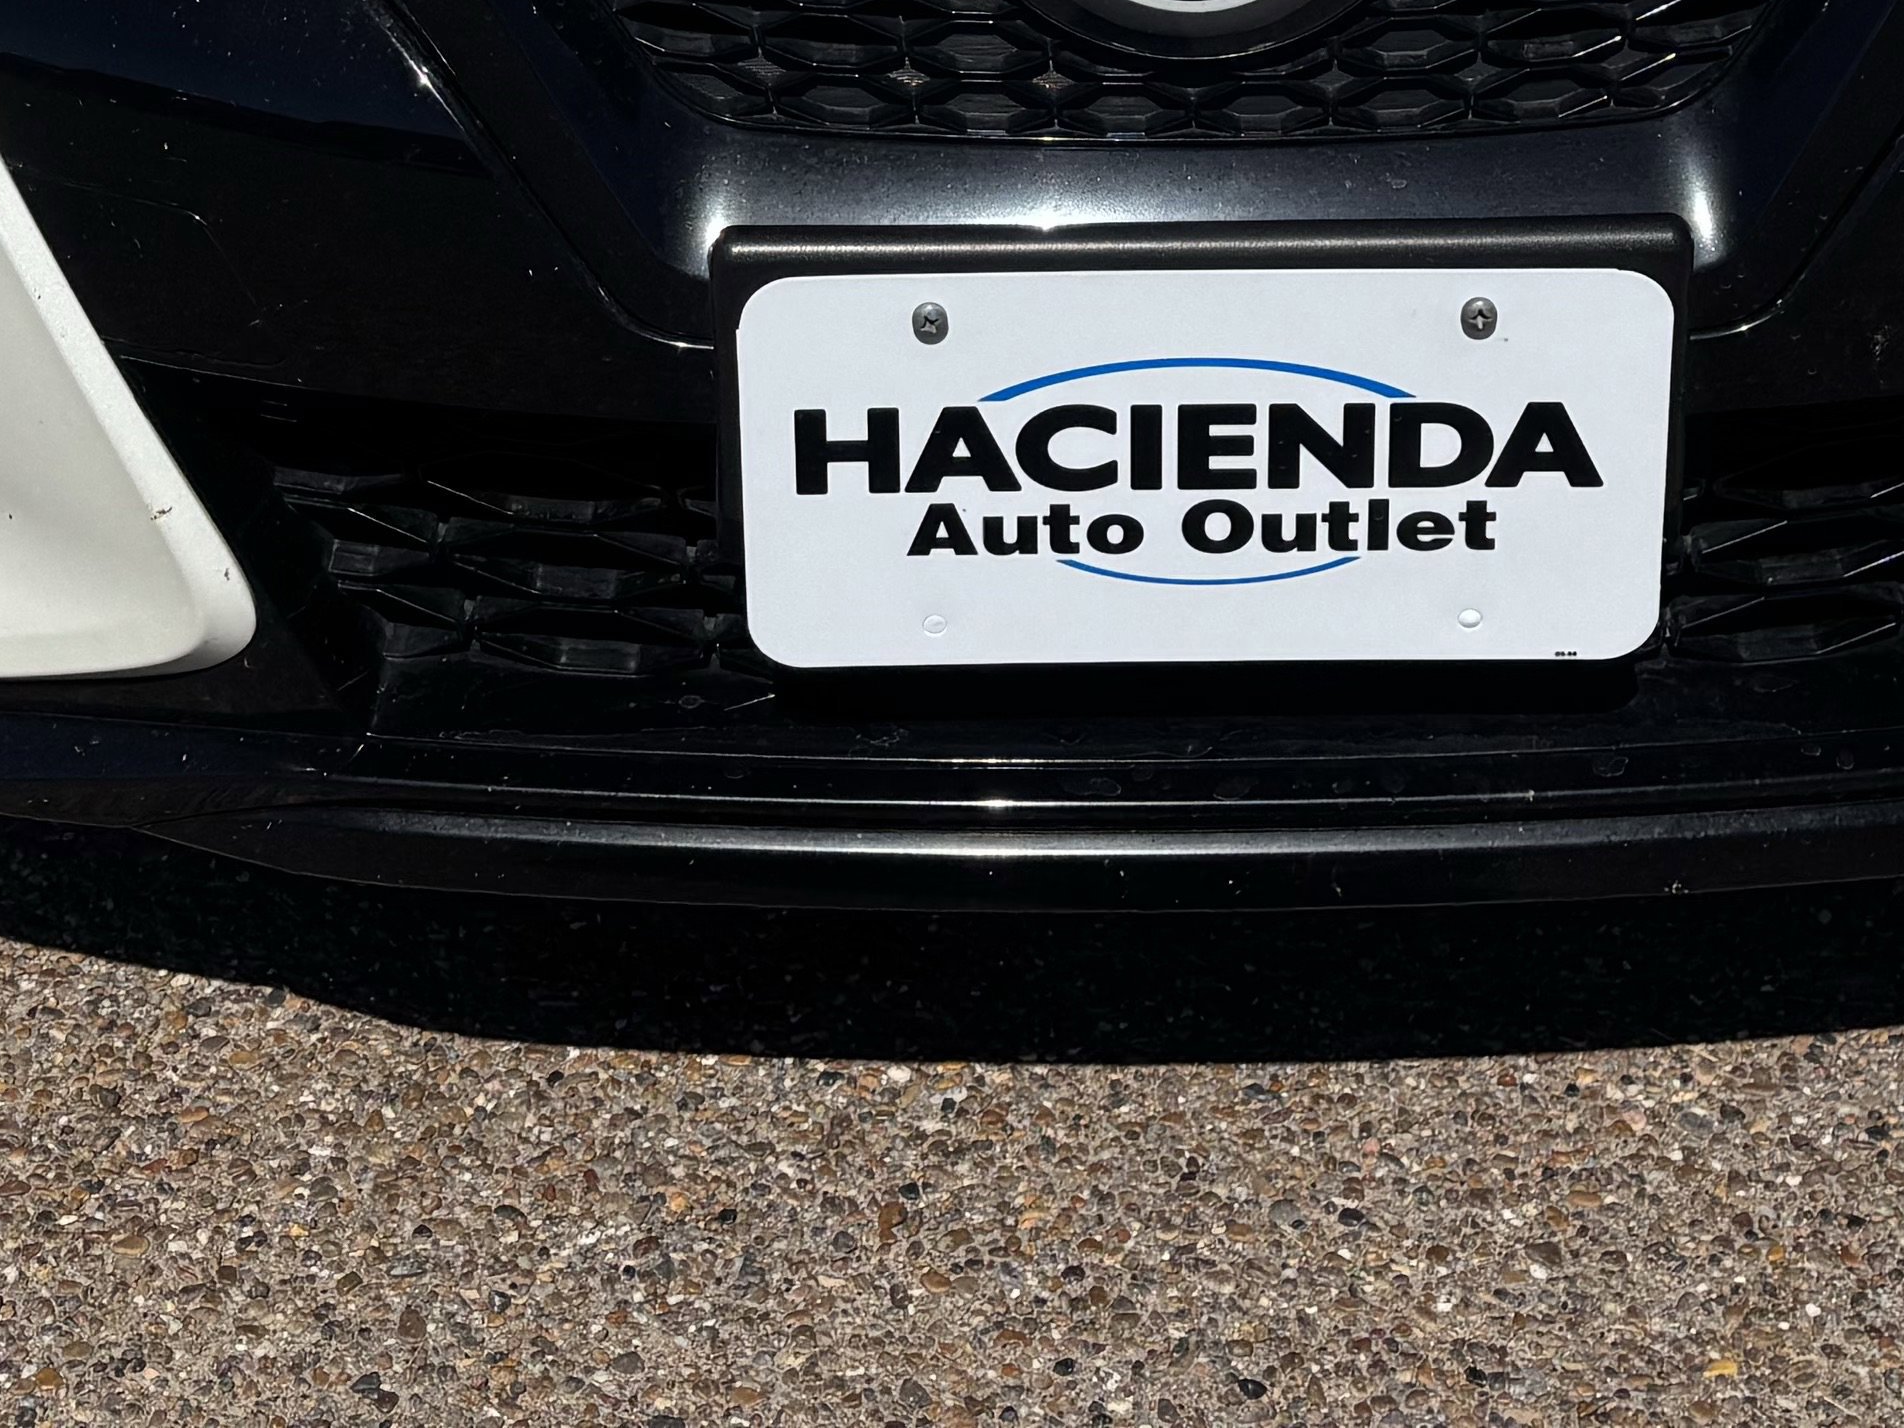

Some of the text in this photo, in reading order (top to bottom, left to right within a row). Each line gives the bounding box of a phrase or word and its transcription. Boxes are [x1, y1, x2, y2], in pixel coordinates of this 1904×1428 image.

[794, 401, 1604, 494] HACIENDA
[906, 498, 1497, 557] Auto Outlet
